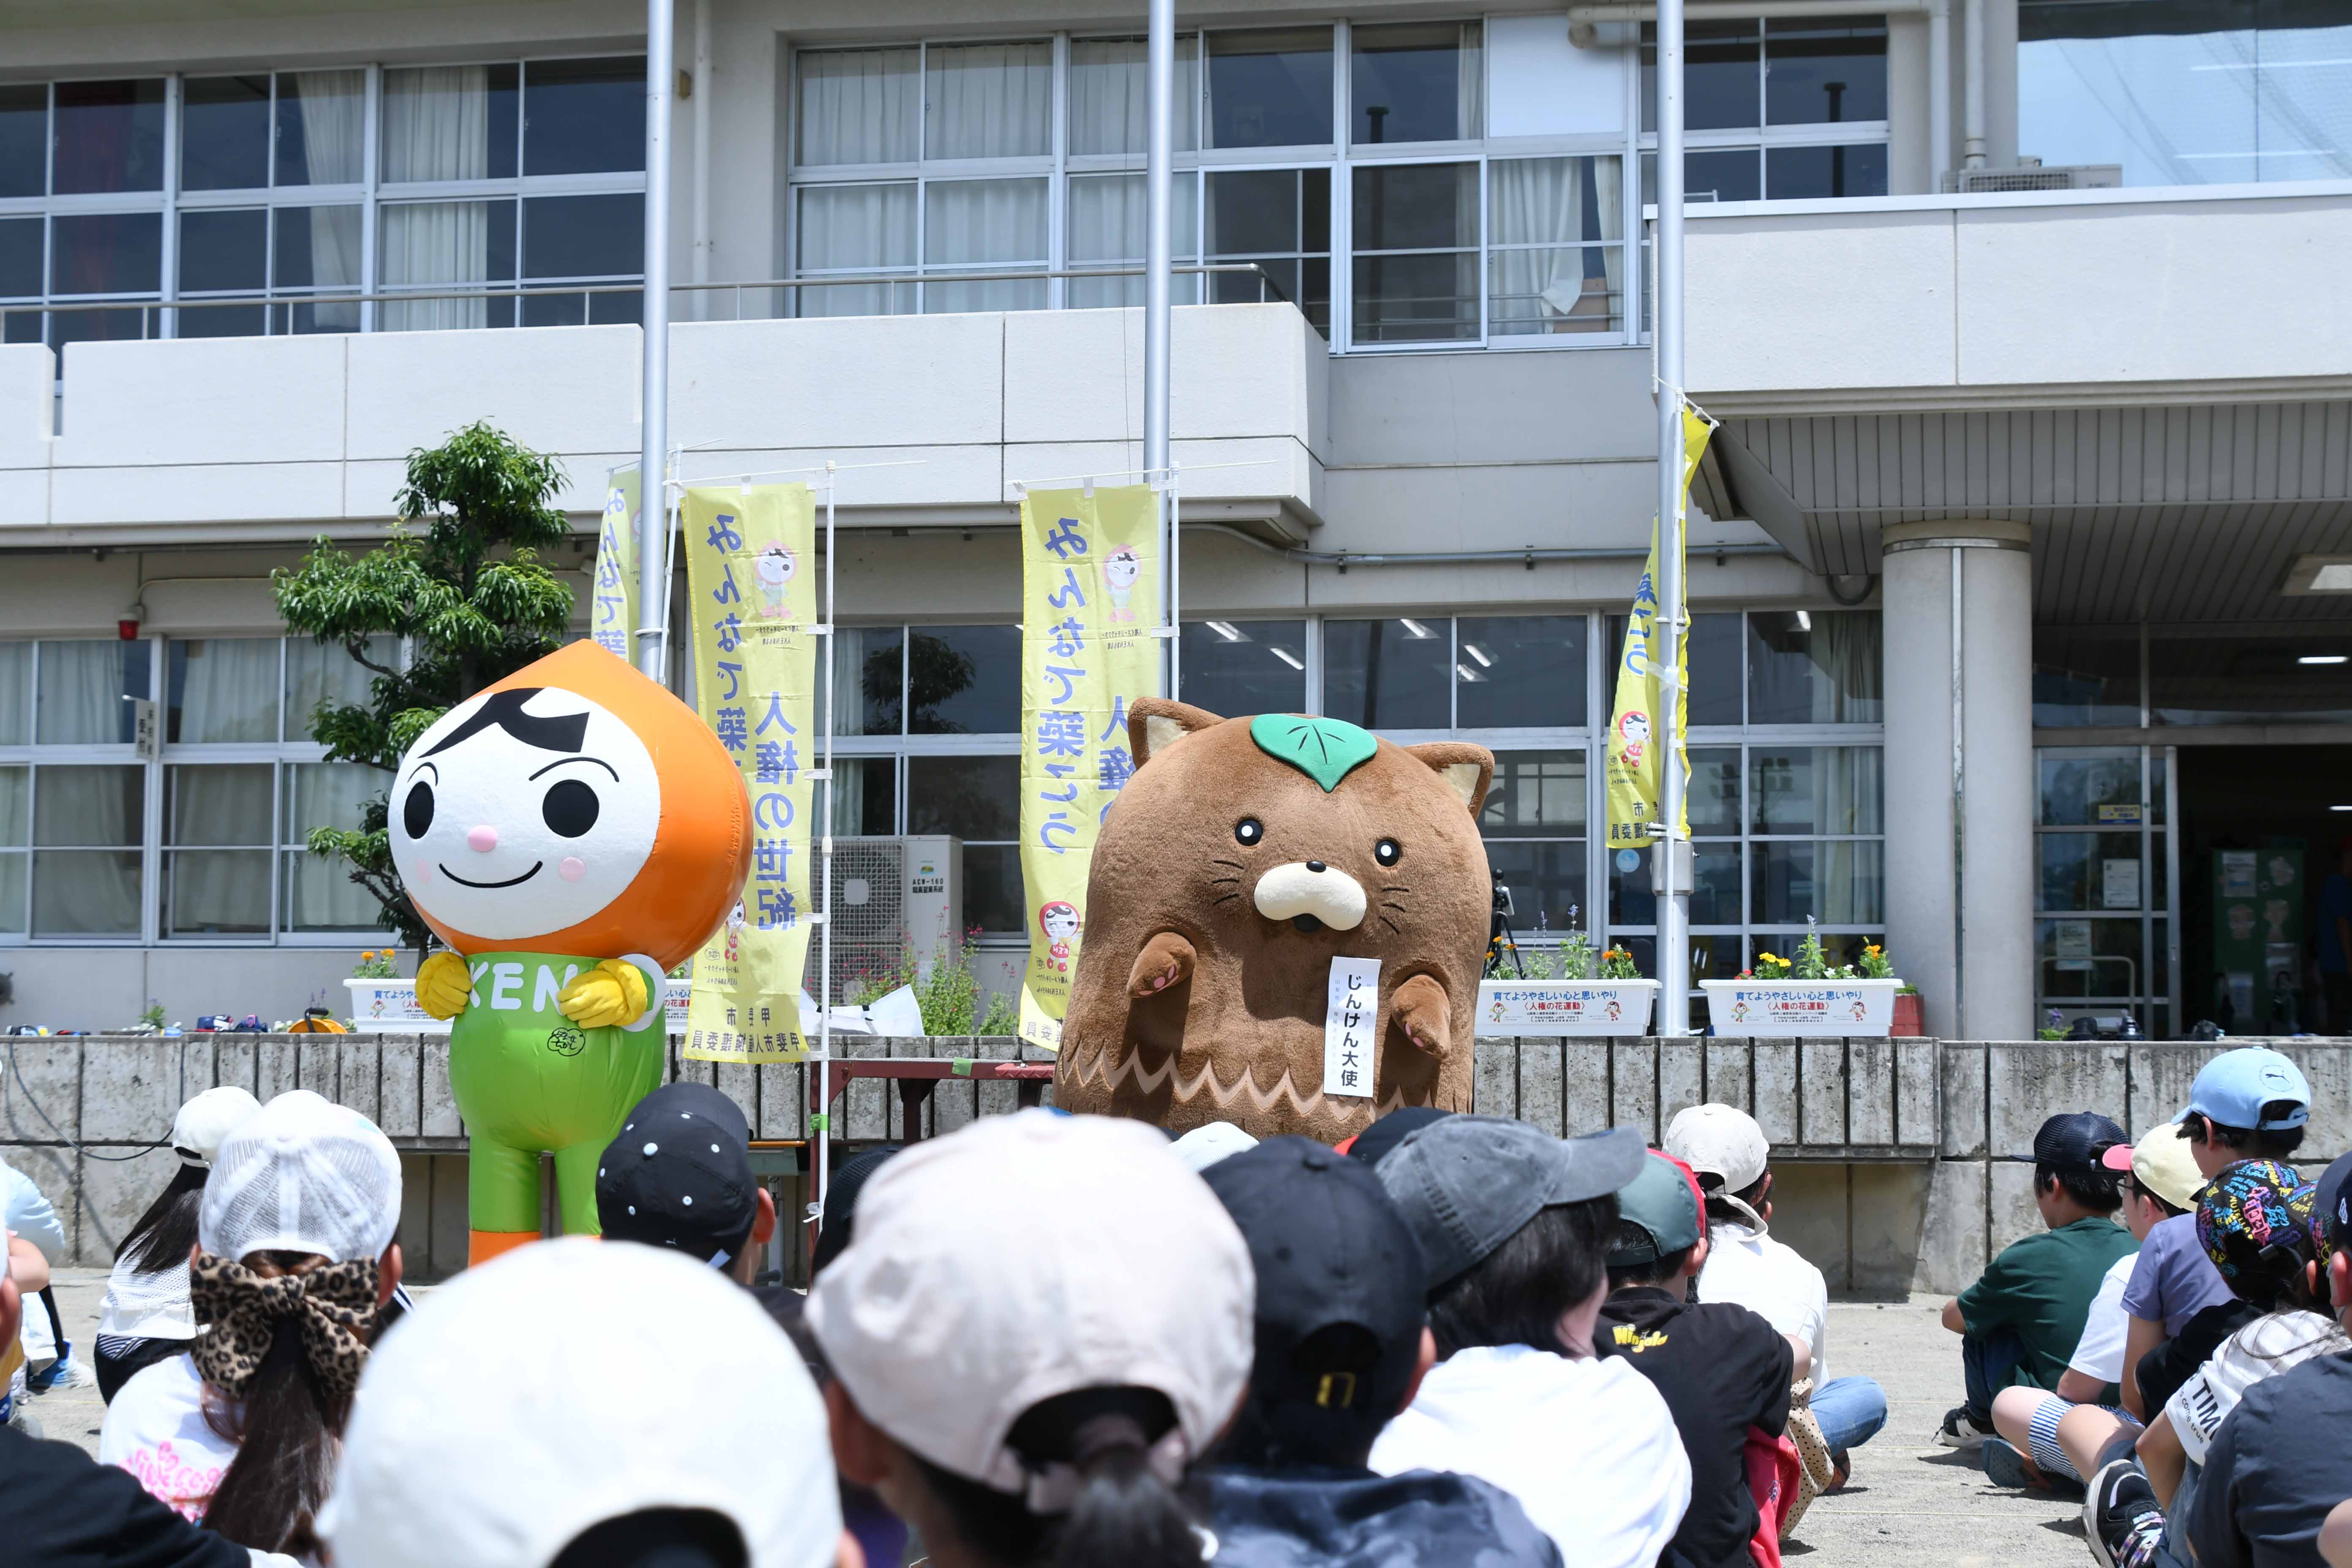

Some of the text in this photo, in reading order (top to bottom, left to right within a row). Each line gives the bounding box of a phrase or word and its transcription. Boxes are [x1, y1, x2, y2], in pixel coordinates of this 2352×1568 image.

[1493, 991, 1617, 1001] 育てようやさしい心と思いやり
[1736, 991, 1862, 1001] 育てようやさしい心と思いやり
[1341, 974, 1362, 1088] じんけん大使
[2230, 1196, 2251, 1233] NUTELLA
[2181, 1398, 2191, 1422] come
[2191, 1423, 2203, 1444] true
